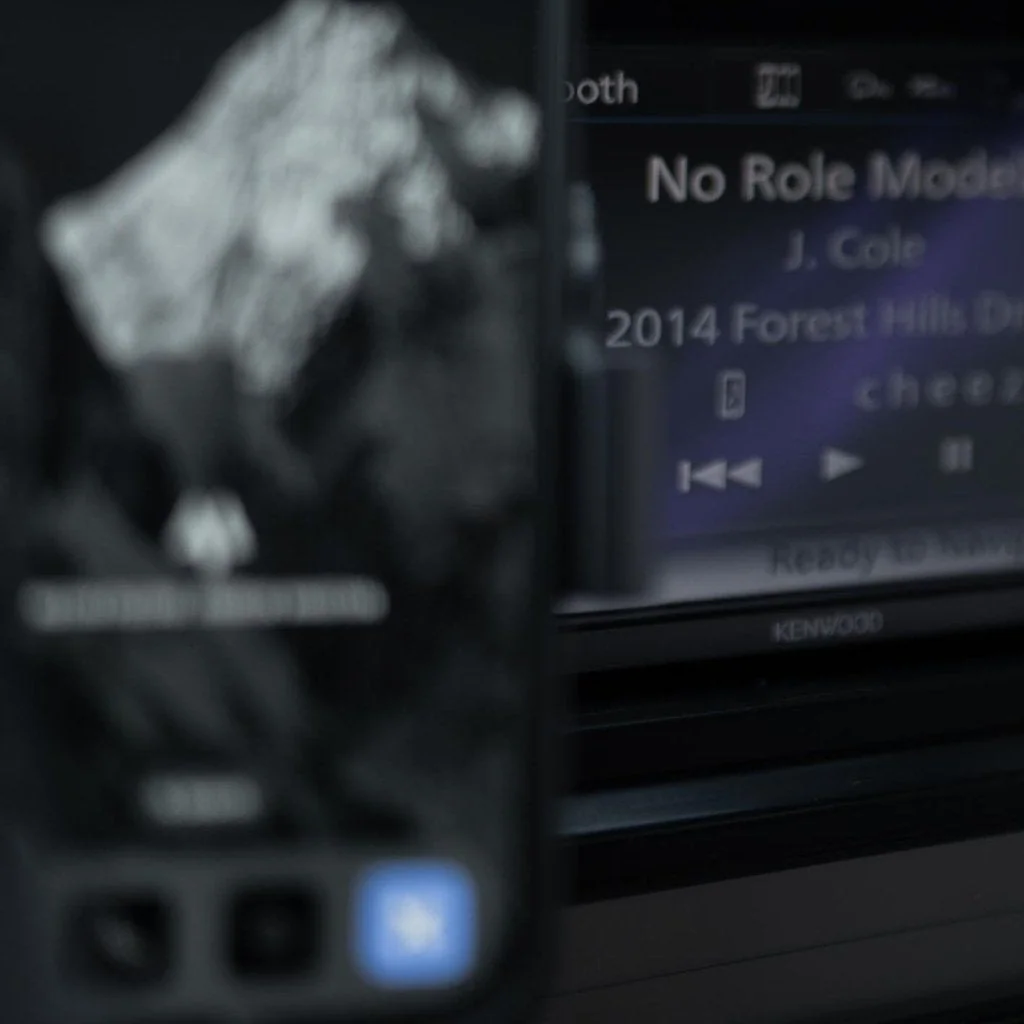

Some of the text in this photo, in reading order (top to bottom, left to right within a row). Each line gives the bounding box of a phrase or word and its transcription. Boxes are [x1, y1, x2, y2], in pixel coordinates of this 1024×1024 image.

[646, 153, 727, 203] No
[741, 147, 856, 202] Role
[784, 222, 927, 272] J. Cole
[605, 304, 720, 348] 2014
[730, 298, 868, 344] Forest
[772, 609, 884, 642] KENWOOD
